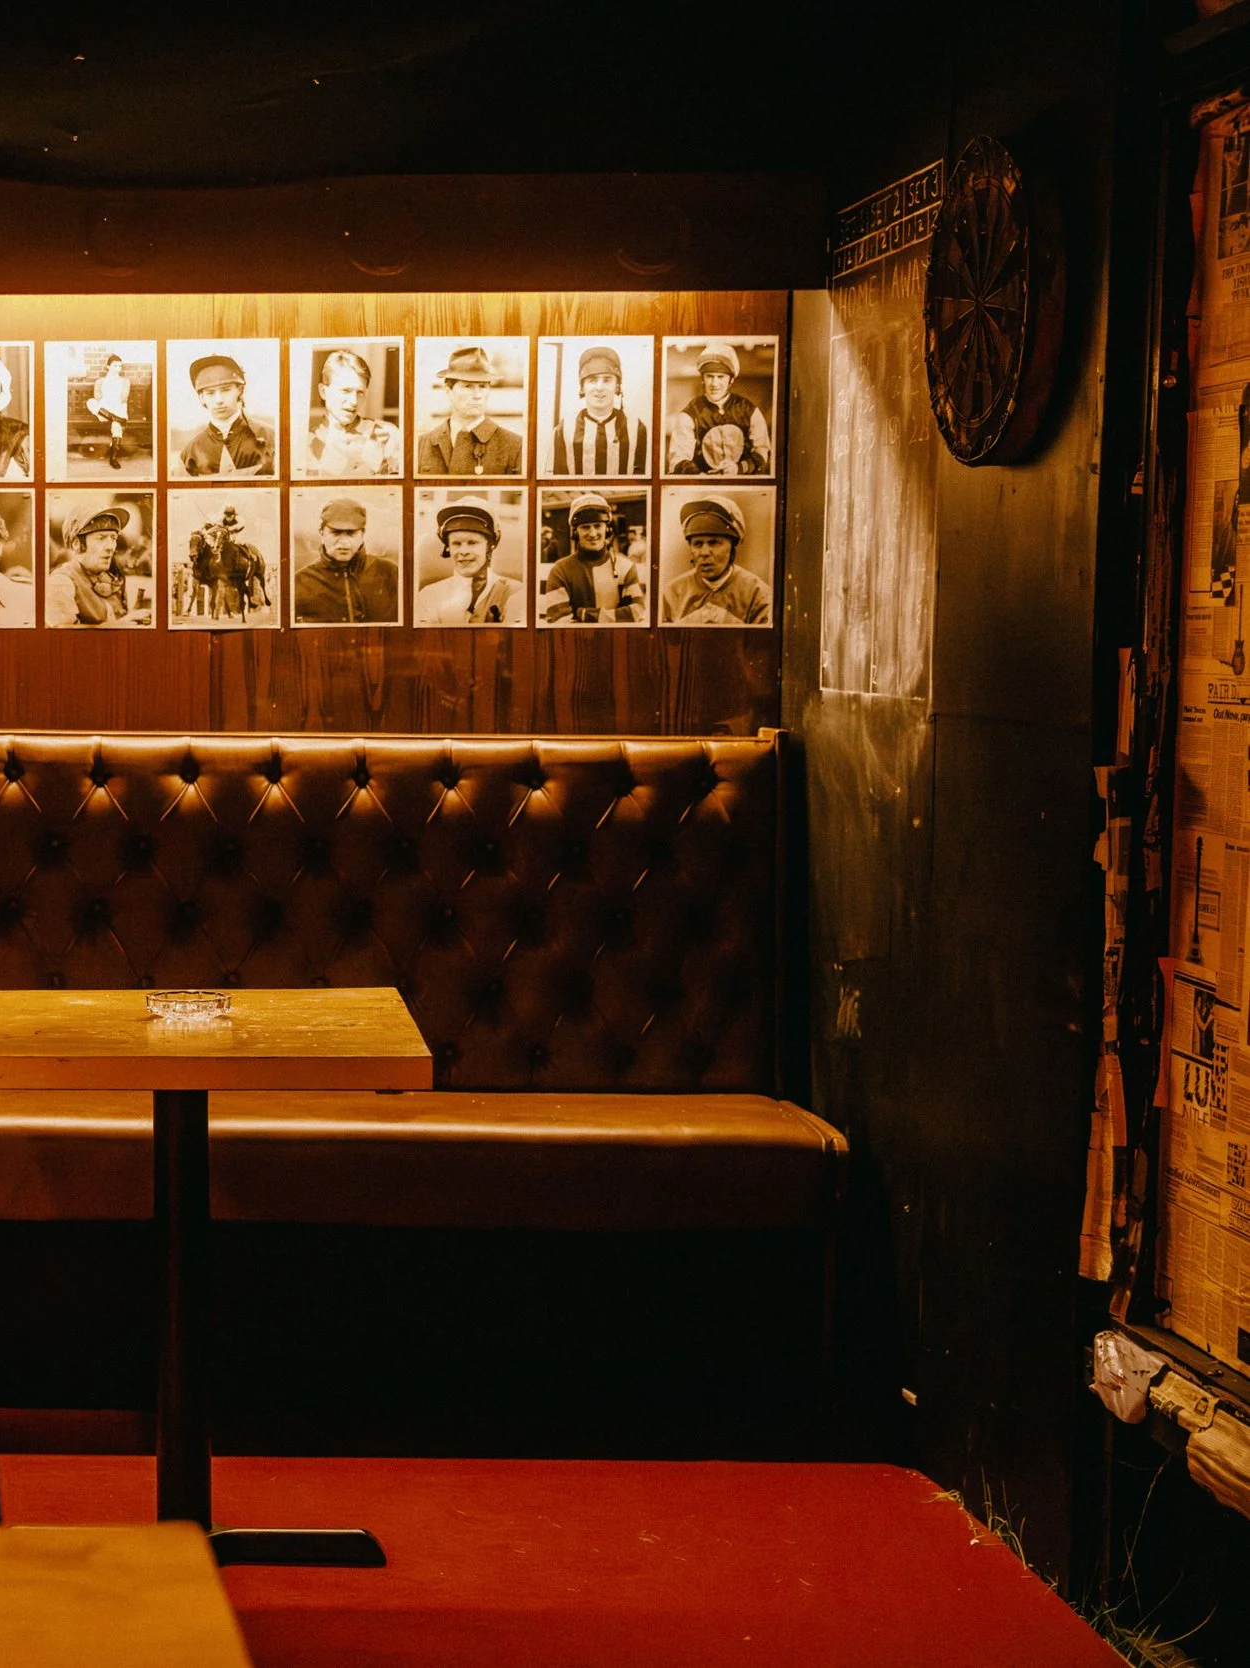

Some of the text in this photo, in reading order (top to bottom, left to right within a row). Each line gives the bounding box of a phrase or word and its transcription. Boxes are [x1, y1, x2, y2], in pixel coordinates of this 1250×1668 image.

[893, 188, 901, 218] 2
[908, 168, 939, 208] SET 3
[879, 232, 888, 250] 2
[838, 275, 878, 318] HOME
